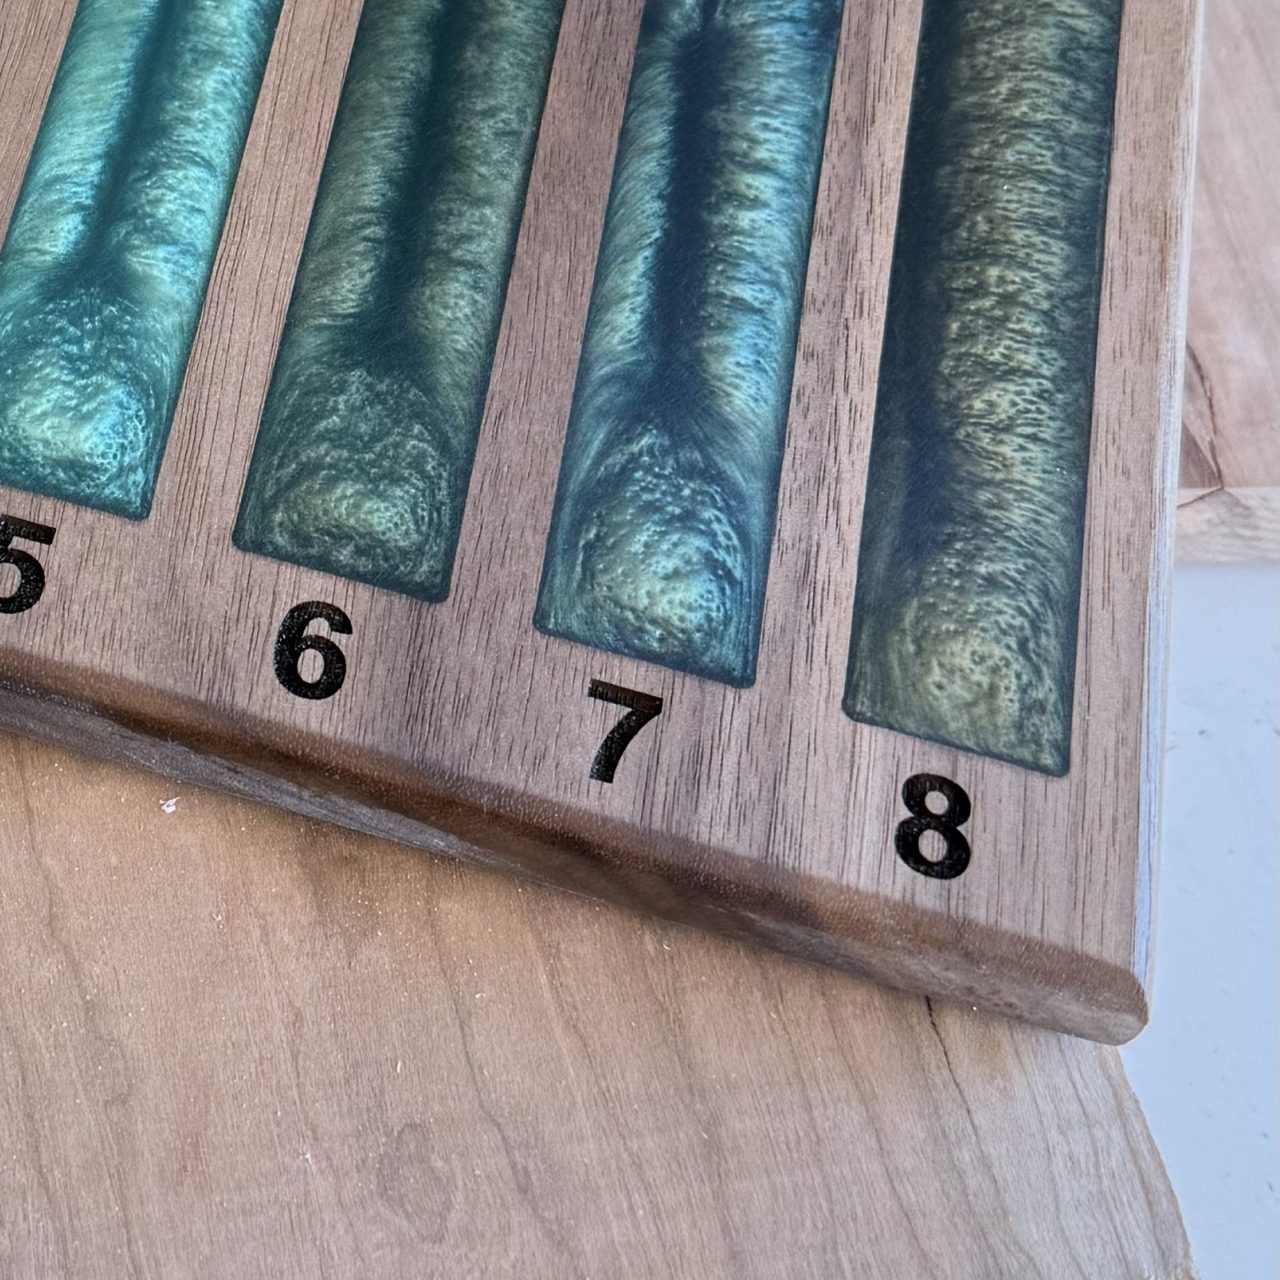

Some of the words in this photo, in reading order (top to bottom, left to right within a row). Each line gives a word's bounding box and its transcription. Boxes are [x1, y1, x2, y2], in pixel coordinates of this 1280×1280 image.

[274, 601, 352, 700] 6
[588, 679, 663, 783] 7
[895, 773, 971, 880] 8
